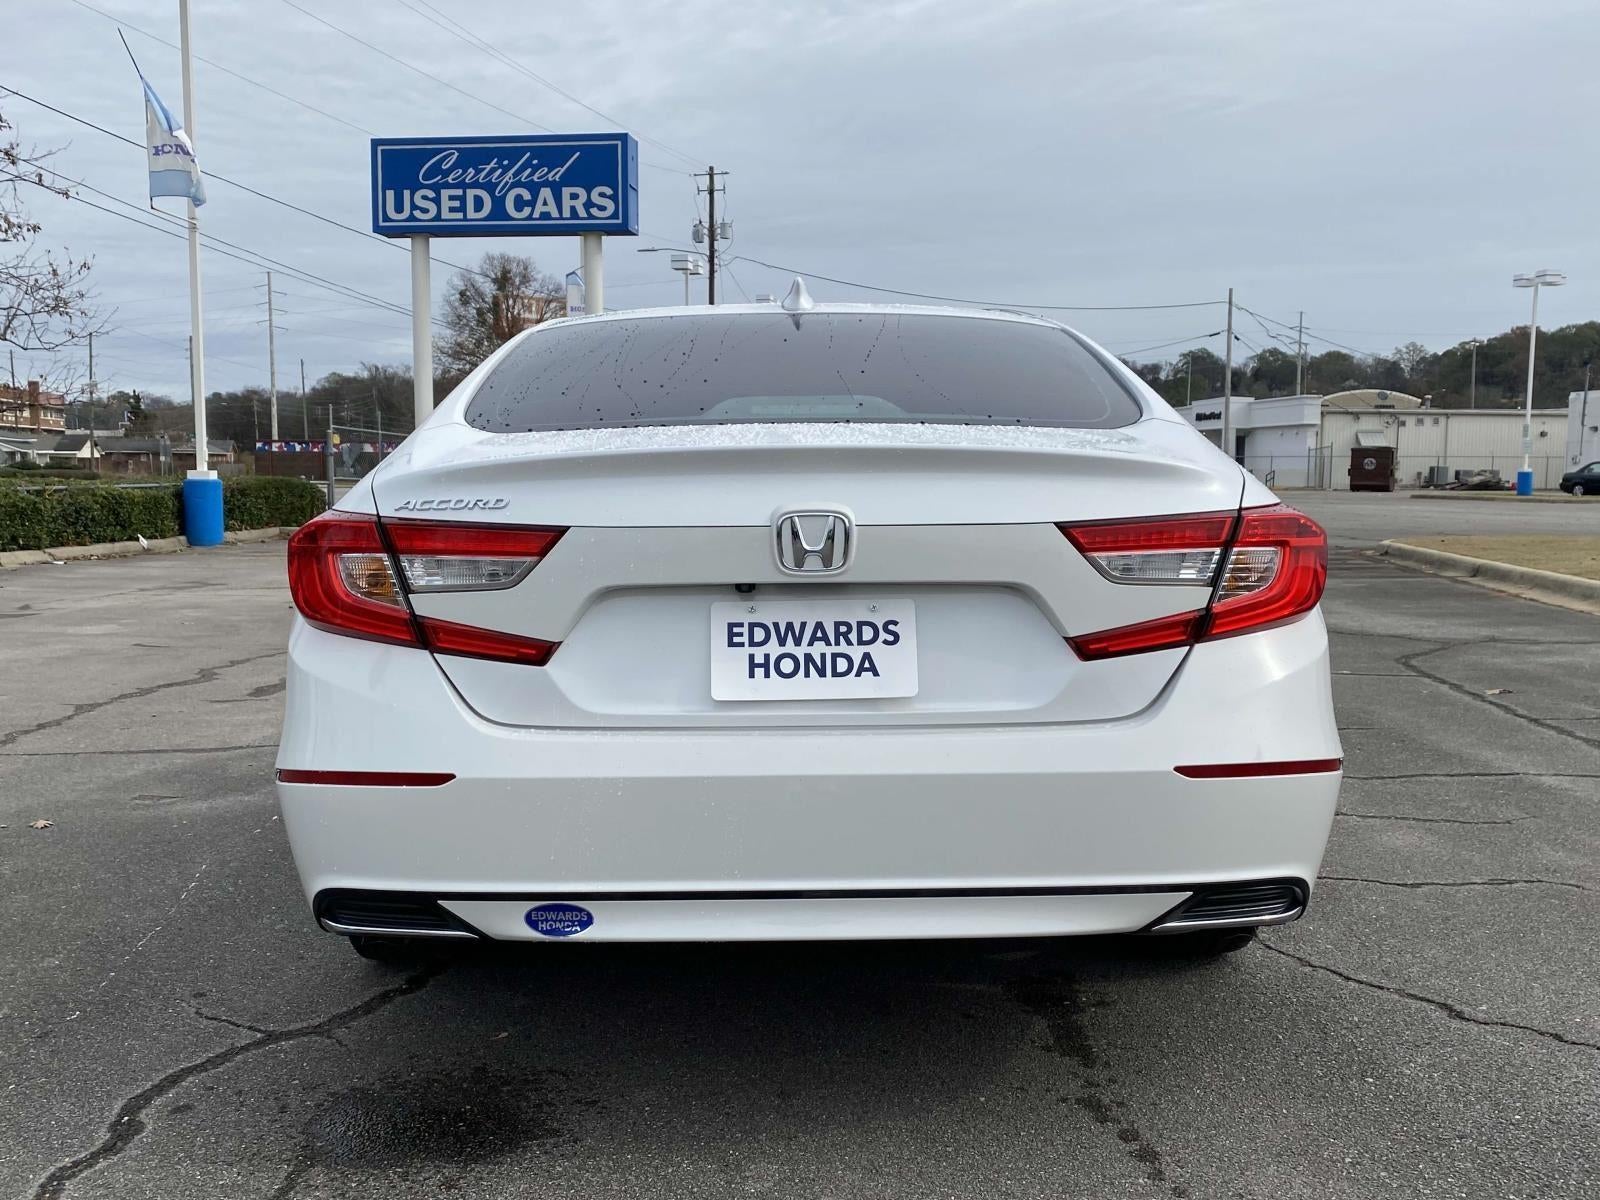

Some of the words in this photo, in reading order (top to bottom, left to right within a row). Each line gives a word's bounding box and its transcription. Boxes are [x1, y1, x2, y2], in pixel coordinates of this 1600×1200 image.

[418, 149, 581, 197] Certified
[385, 187, 492, 220] USED
[505, 186, 616, 219] CARS
[394, 499, 511, 511] ACCORD
[726, 620, 900, 648] EDWARDS
[748, 652, 880, 679] HONDA
[531, 911, 588, 921] EDWARDS
[538, 921, 581, 931] HONDA
